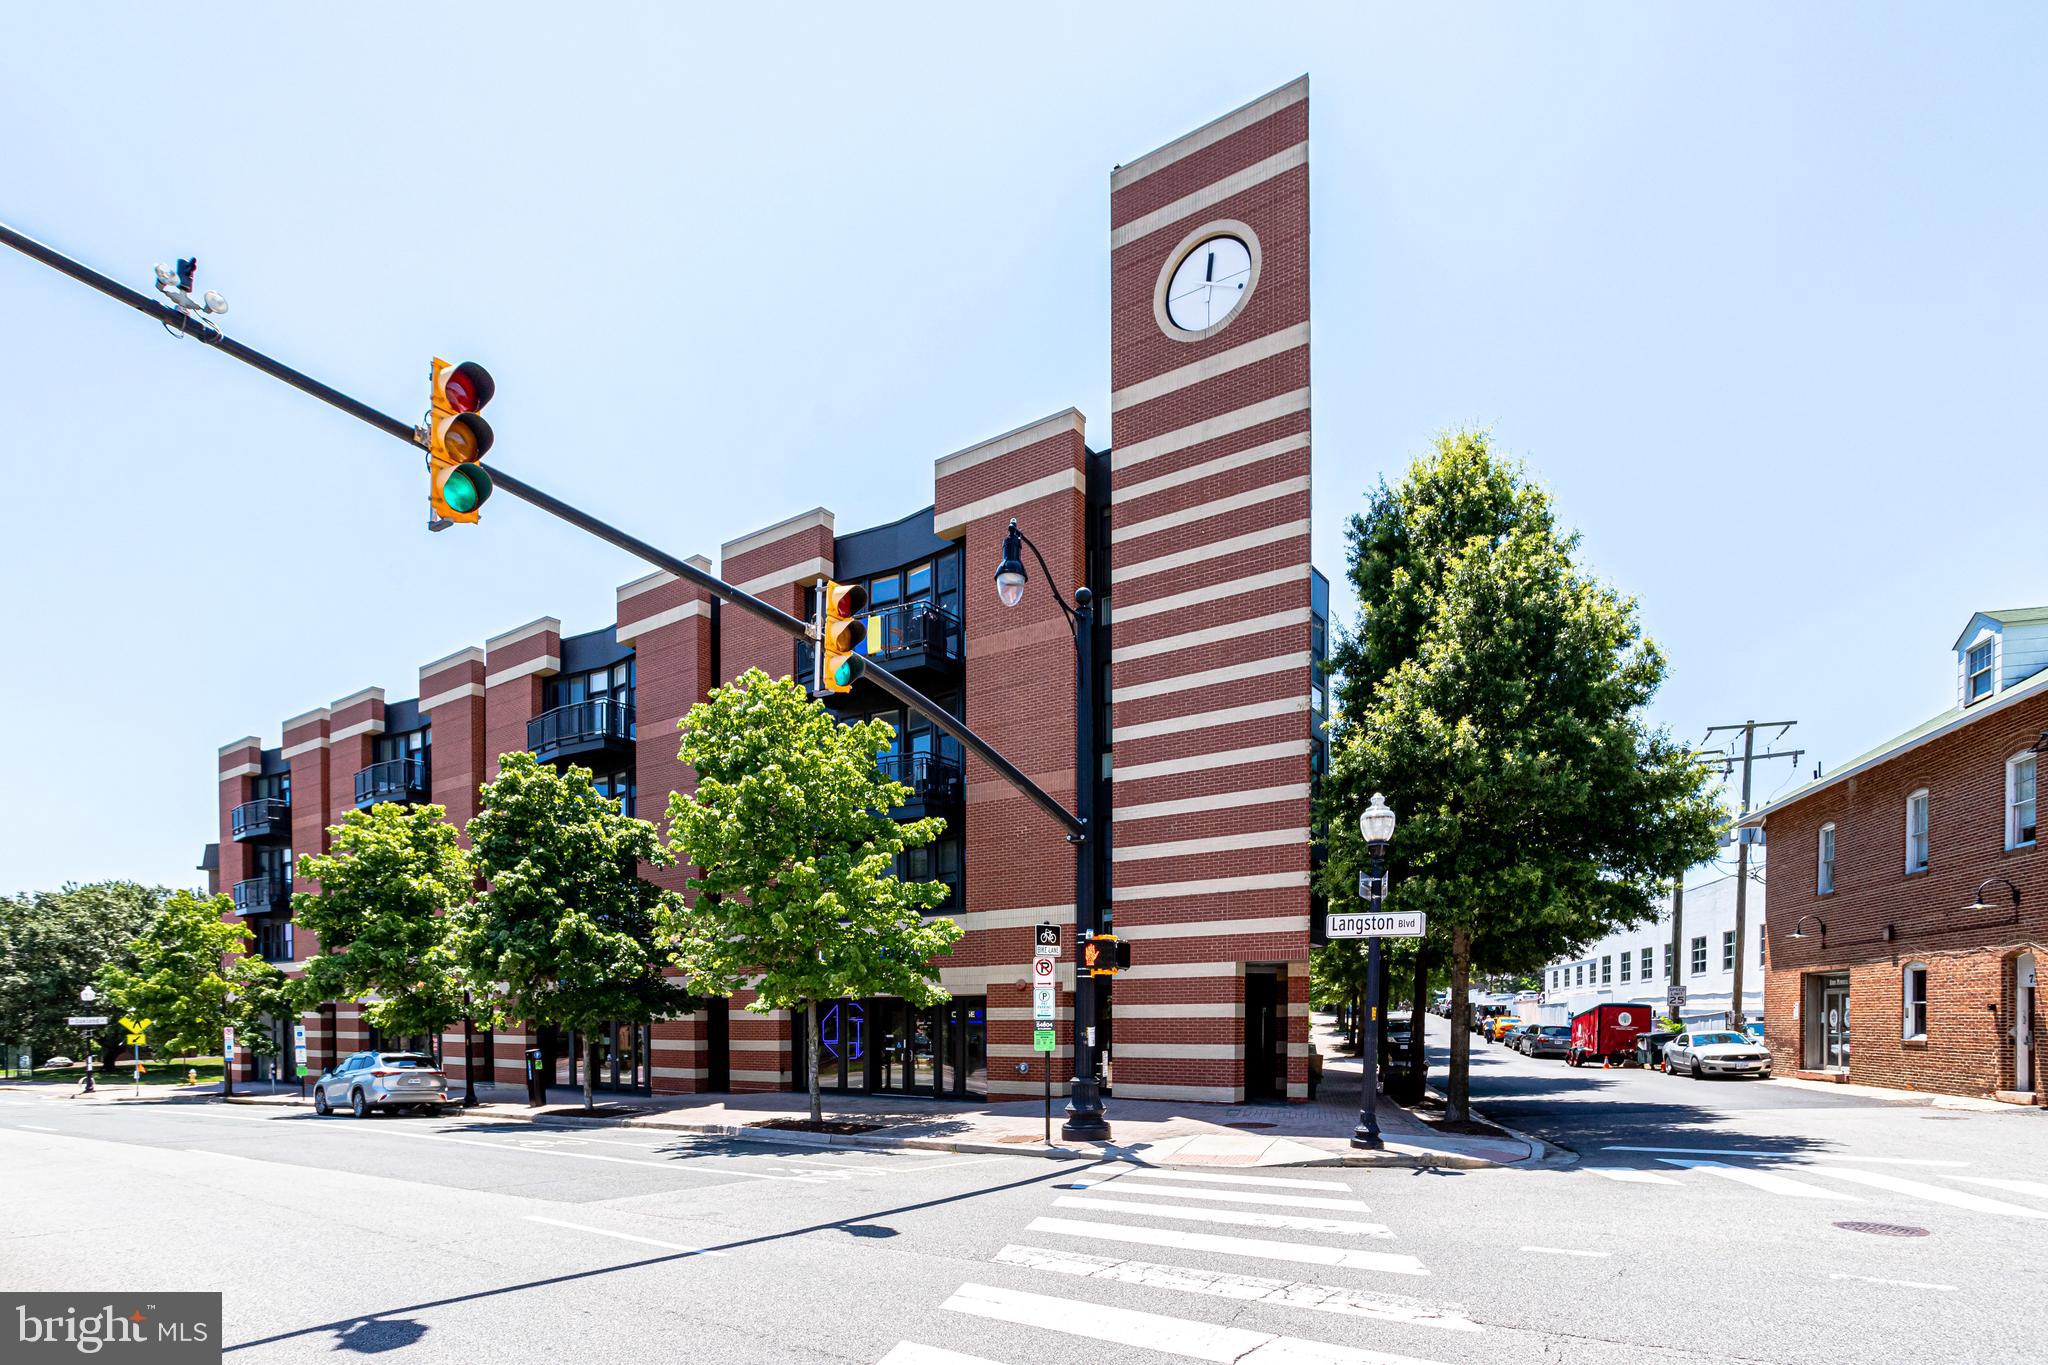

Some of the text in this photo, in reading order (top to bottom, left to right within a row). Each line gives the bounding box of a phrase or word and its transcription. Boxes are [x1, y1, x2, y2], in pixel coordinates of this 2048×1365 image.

[1332, 916, 1415, 934] Langston Blvd
[1037, 946, 1060, 954] BIKE LANE
[1669, 996, 1684, 1005] 25
